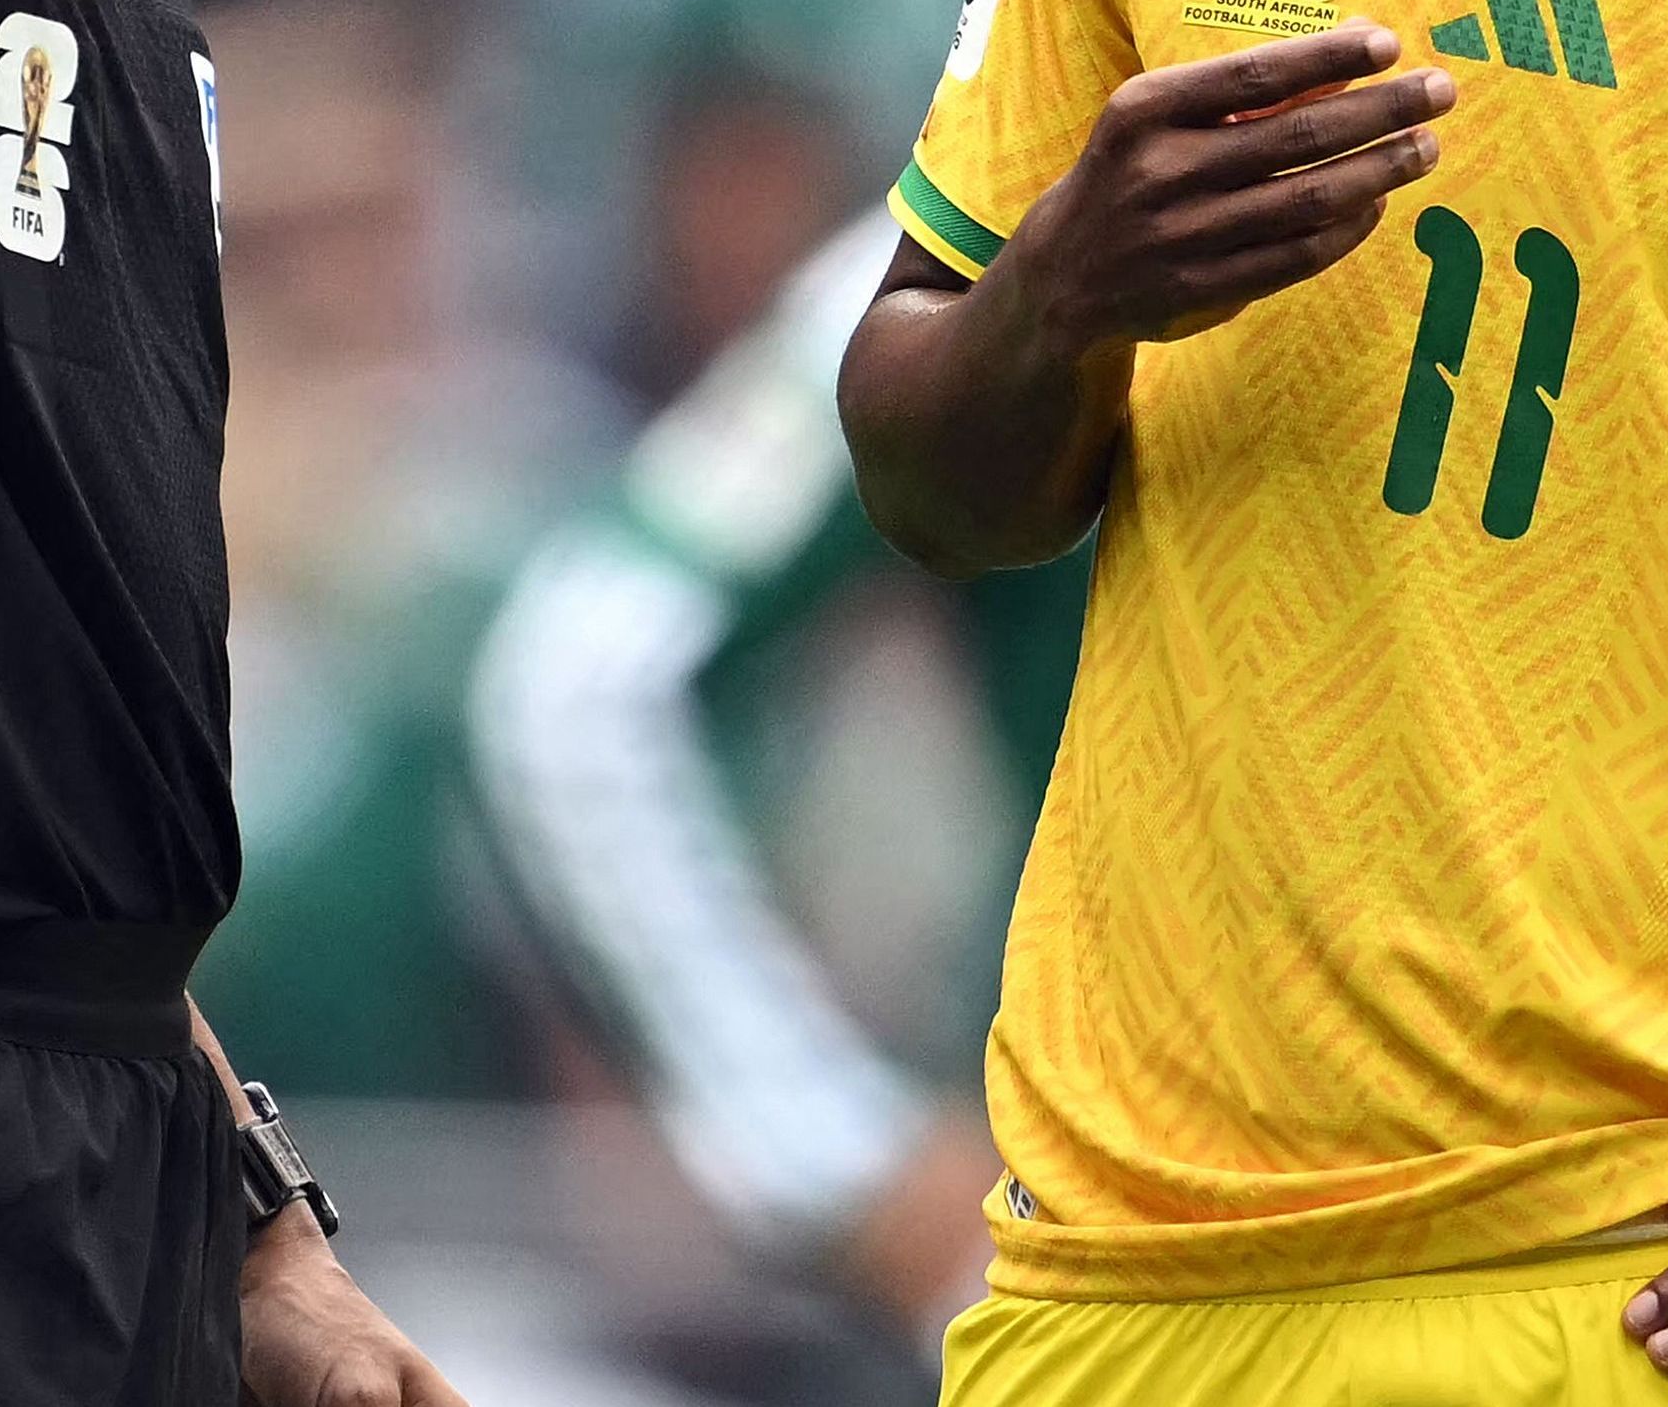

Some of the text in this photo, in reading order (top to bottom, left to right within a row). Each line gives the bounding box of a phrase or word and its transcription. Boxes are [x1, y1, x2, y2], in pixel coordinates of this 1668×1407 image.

[1184, 6, 1255, 27] FOOTBALL
[1270, 1, 1335, 21] AFRICAN
[12, 205, 44, 238] FIFA
[1382, 204, 1580, 541] 11
